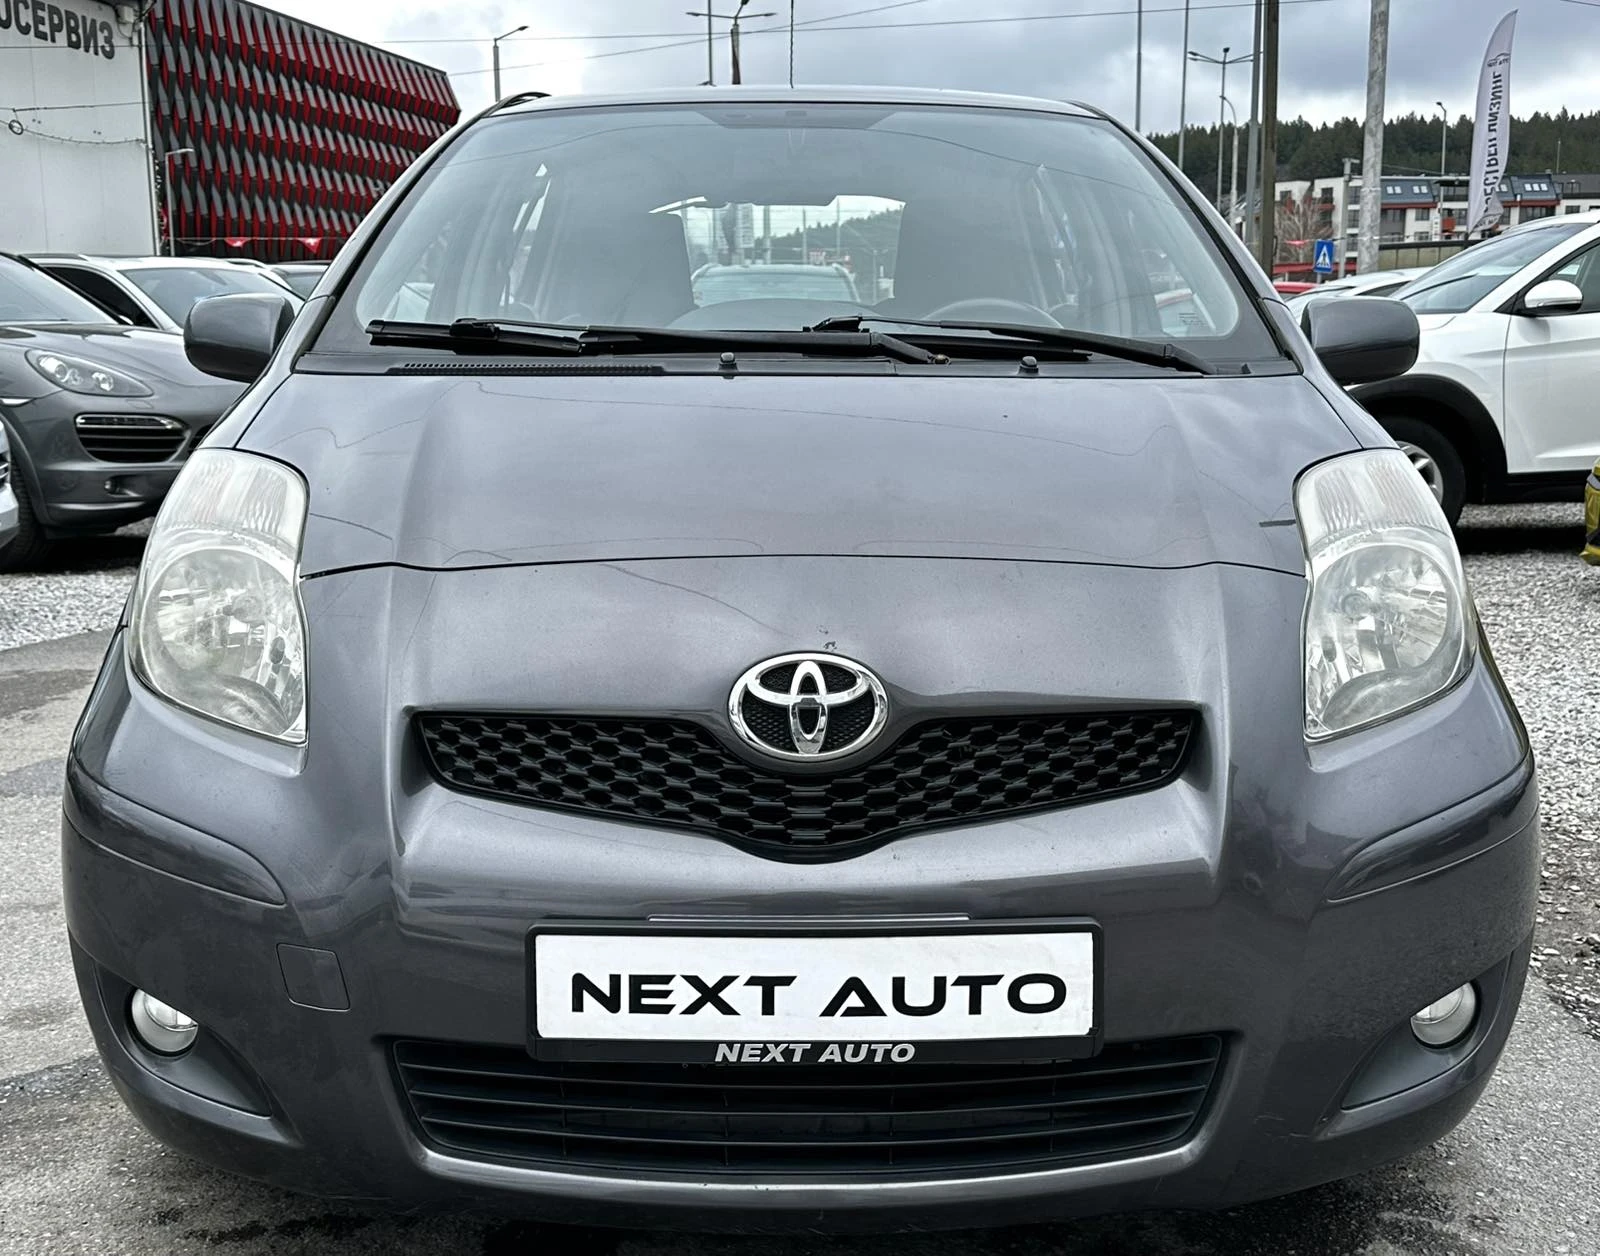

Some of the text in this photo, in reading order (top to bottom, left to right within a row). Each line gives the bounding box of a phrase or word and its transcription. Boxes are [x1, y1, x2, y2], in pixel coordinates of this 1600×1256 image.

[571, 973, 1067, 1017] NEXT AUTO
[714, 1043, 916, 1063] NEXT AUTO
